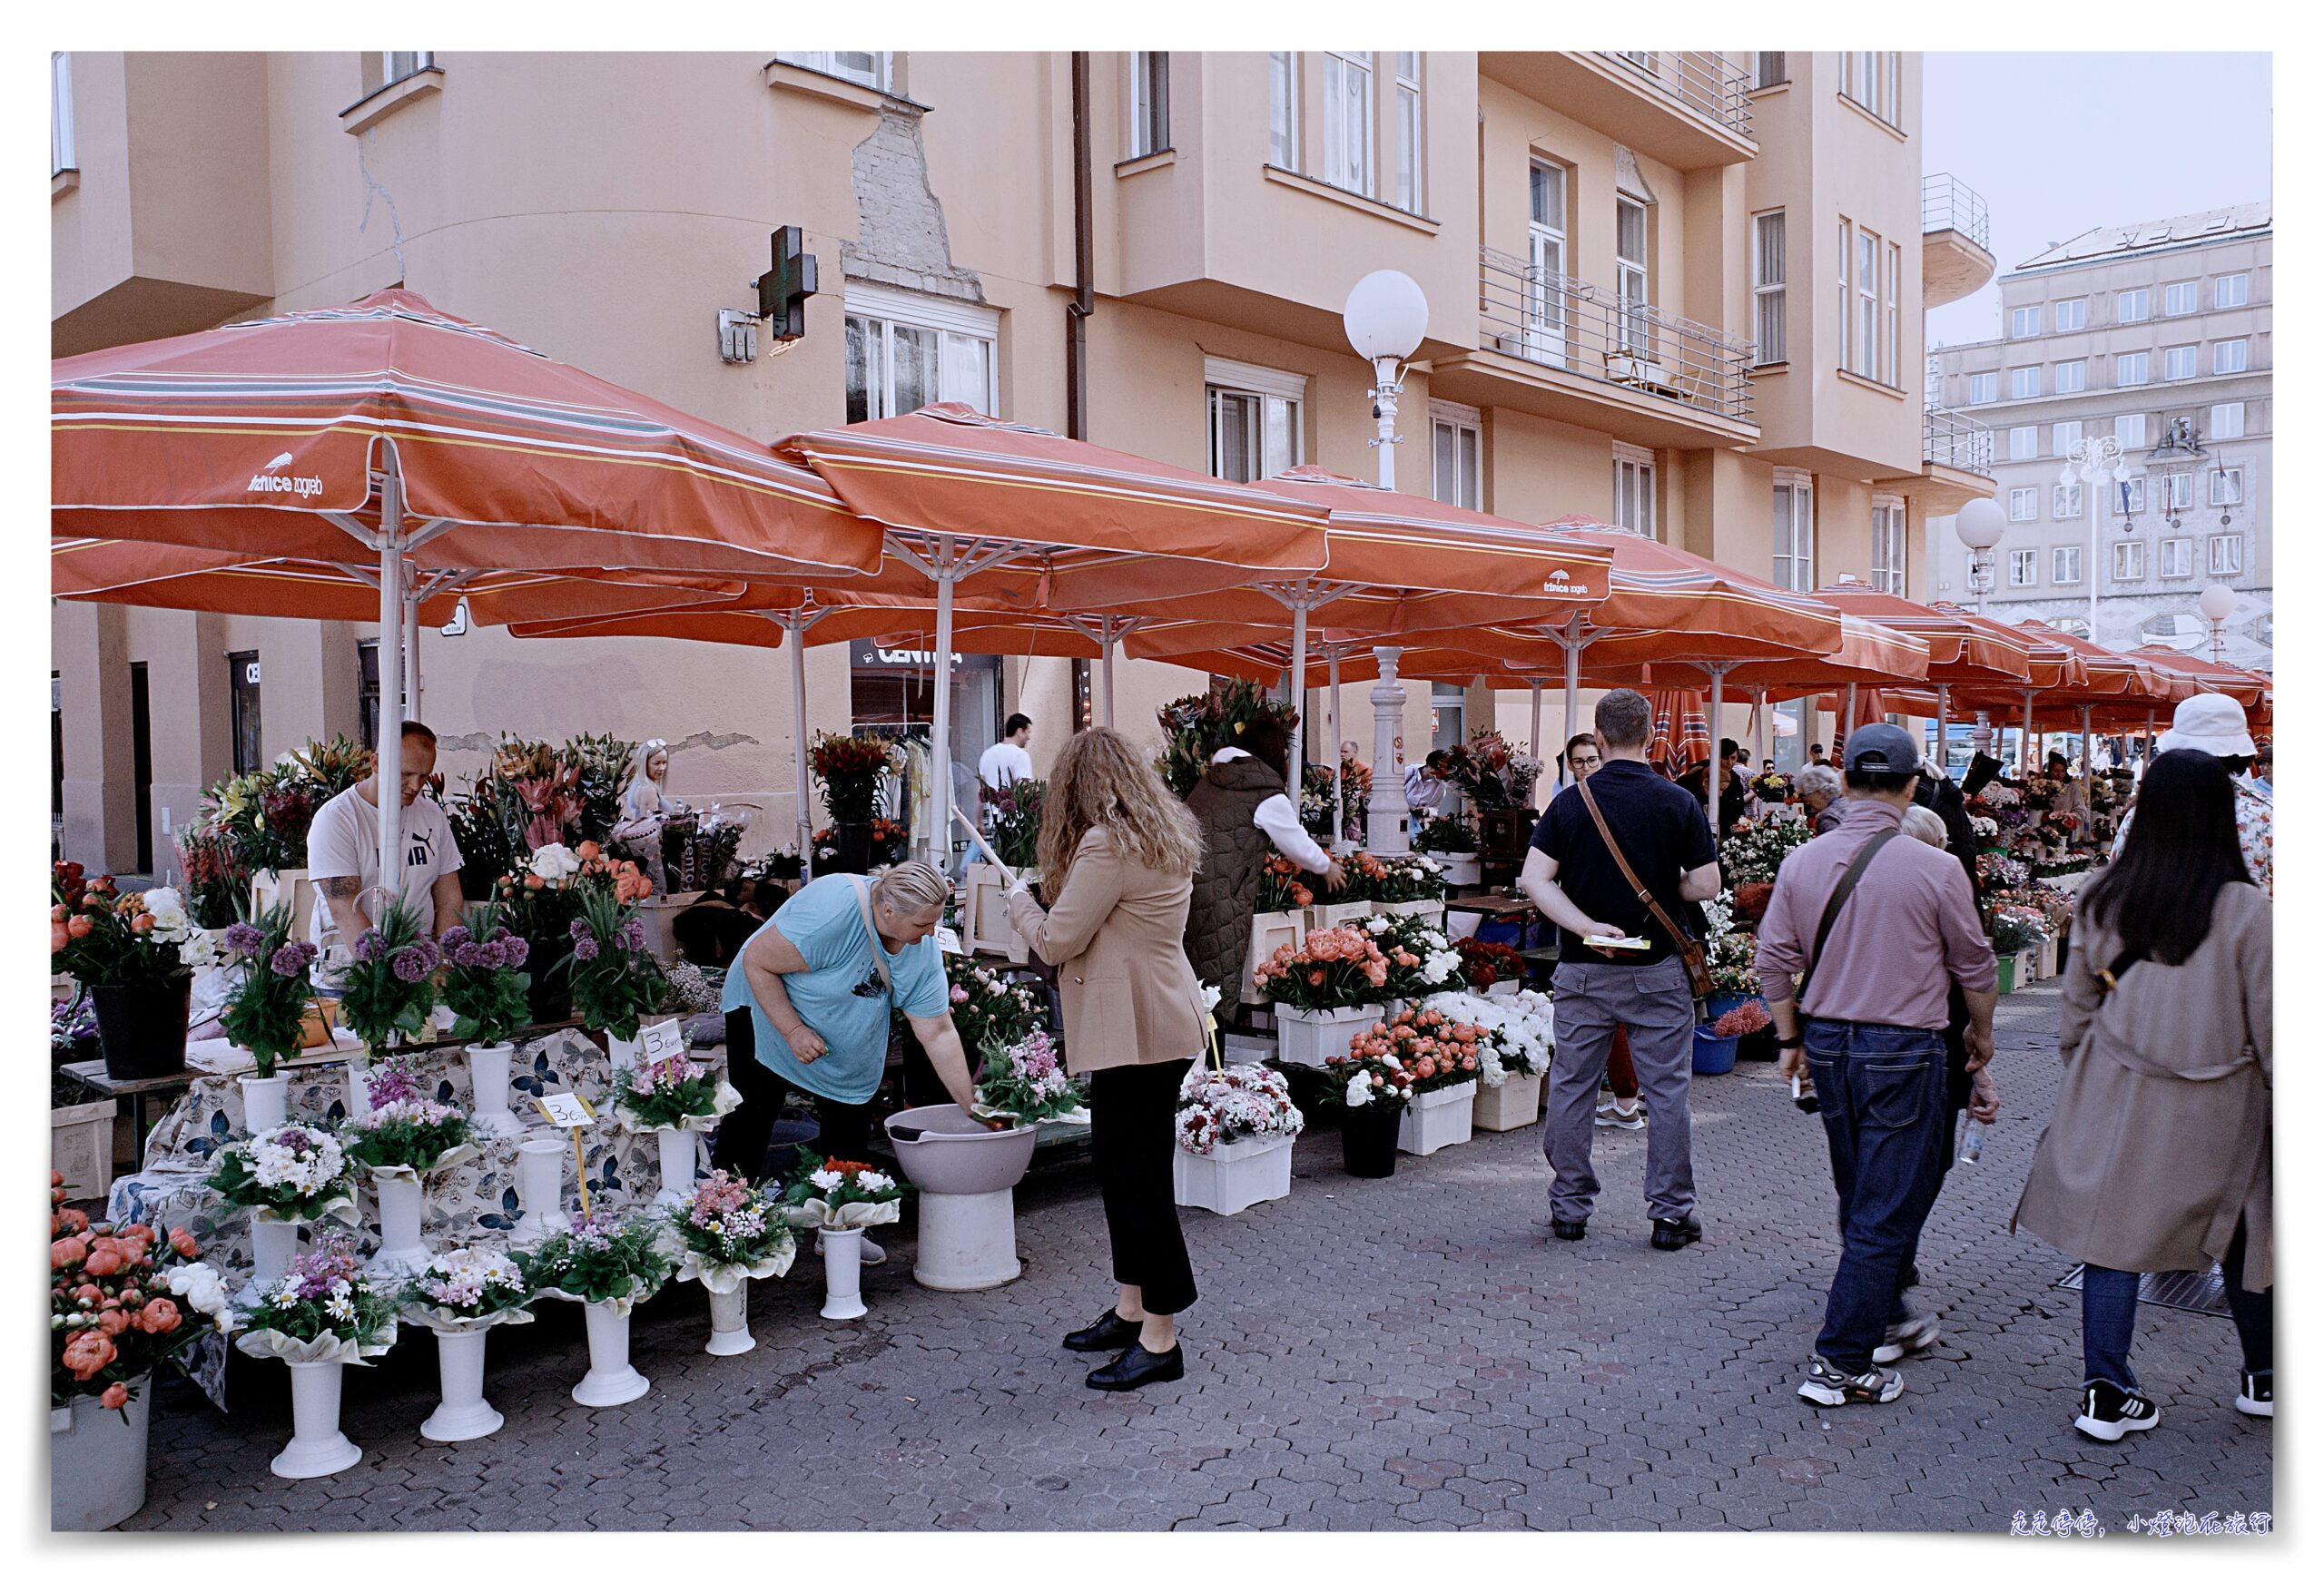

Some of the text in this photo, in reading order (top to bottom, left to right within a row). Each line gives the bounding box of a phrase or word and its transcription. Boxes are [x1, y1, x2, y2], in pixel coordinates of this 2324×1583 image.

[645, 1031, 680, 1054] 3 Eur
[548, 1104, 569, 1122] 3
